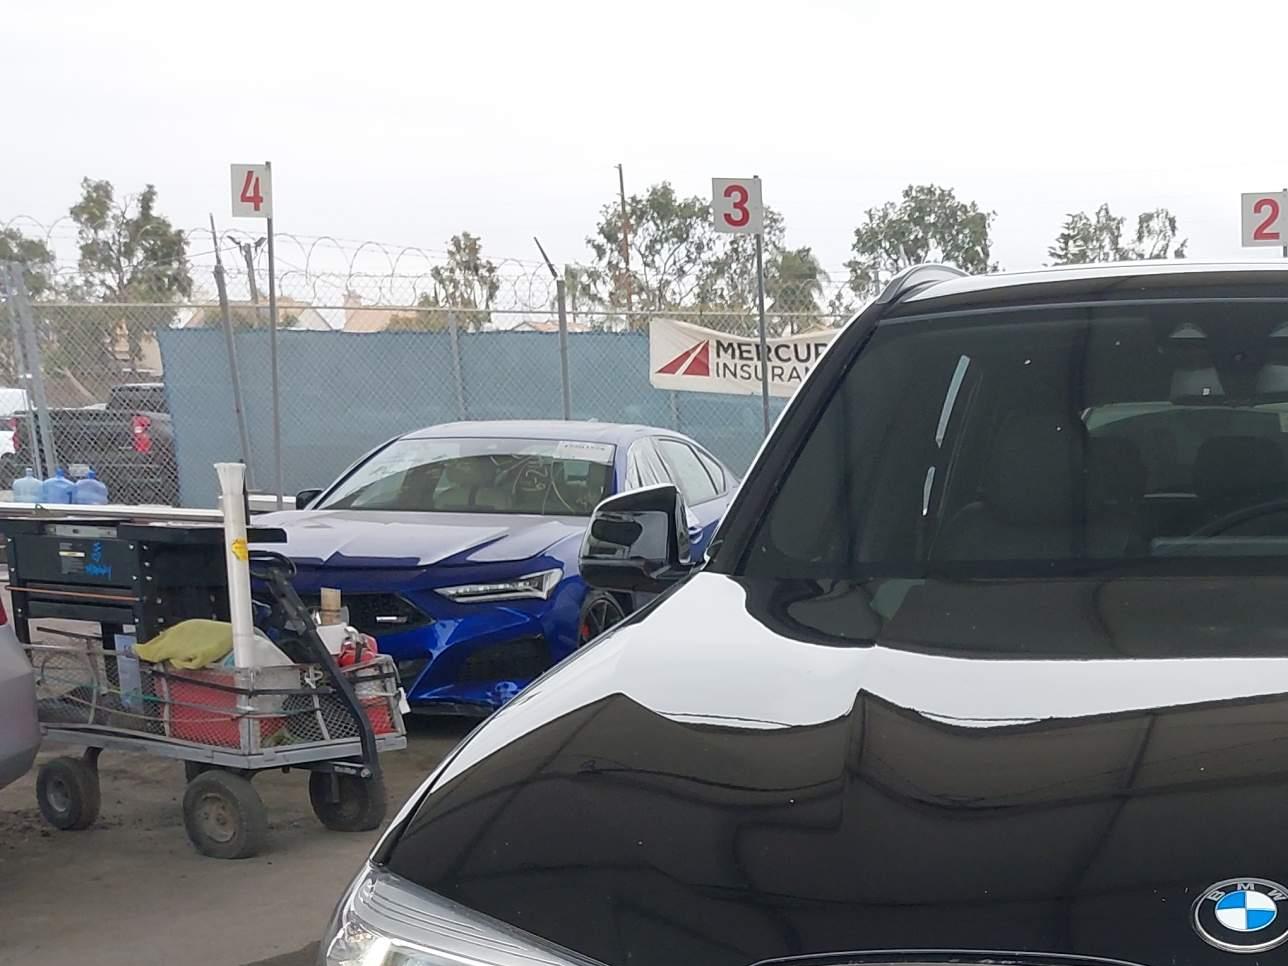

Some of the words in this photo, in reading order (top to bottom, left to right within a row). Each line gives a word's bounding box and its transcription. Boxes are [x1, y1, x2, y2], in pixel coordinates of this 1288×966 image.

[240, 170, 264, 212] 4
[723, 184, 750, 228] 3
[1253, 198, 1281, 241] 2
[1206, 882, 1288, 902] BMW
